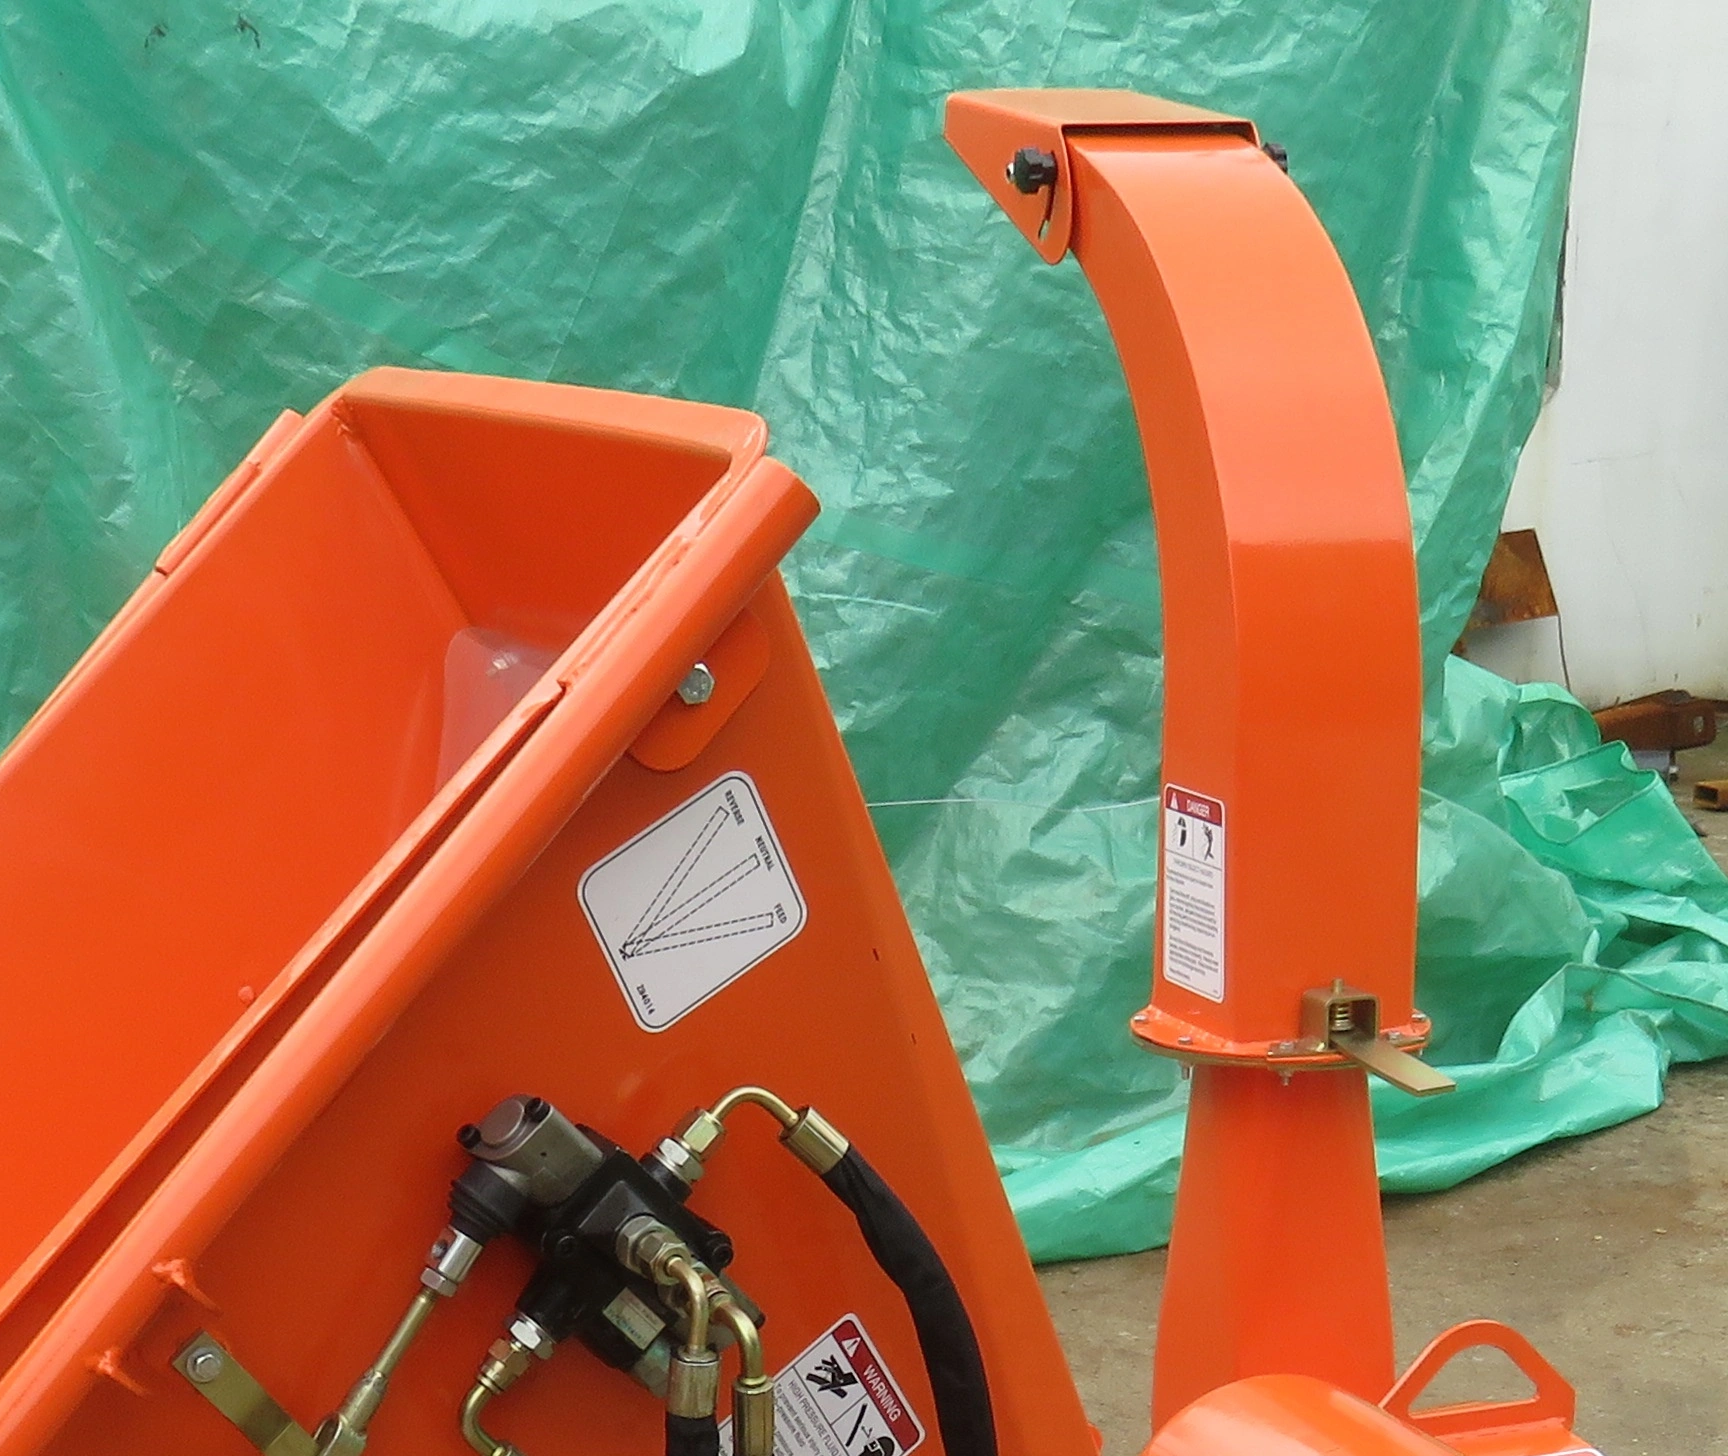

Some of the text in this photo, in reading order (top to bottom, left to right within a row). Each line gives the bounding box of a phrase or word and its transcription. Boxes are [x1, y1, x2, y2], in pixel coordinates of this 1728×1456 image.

[725, 789, 745, 825] REVERSE
[755, 836, 773, 871] NEUTRAL
[775, 903, 787, 923] FEED
[862, 1364, 901, 1421] WARNING
[787, 1380, 802, 1400] HIGH
[798, 1398, 826, 1437] PRESSURE
[822, 1435, 838, 1456] FLUID
